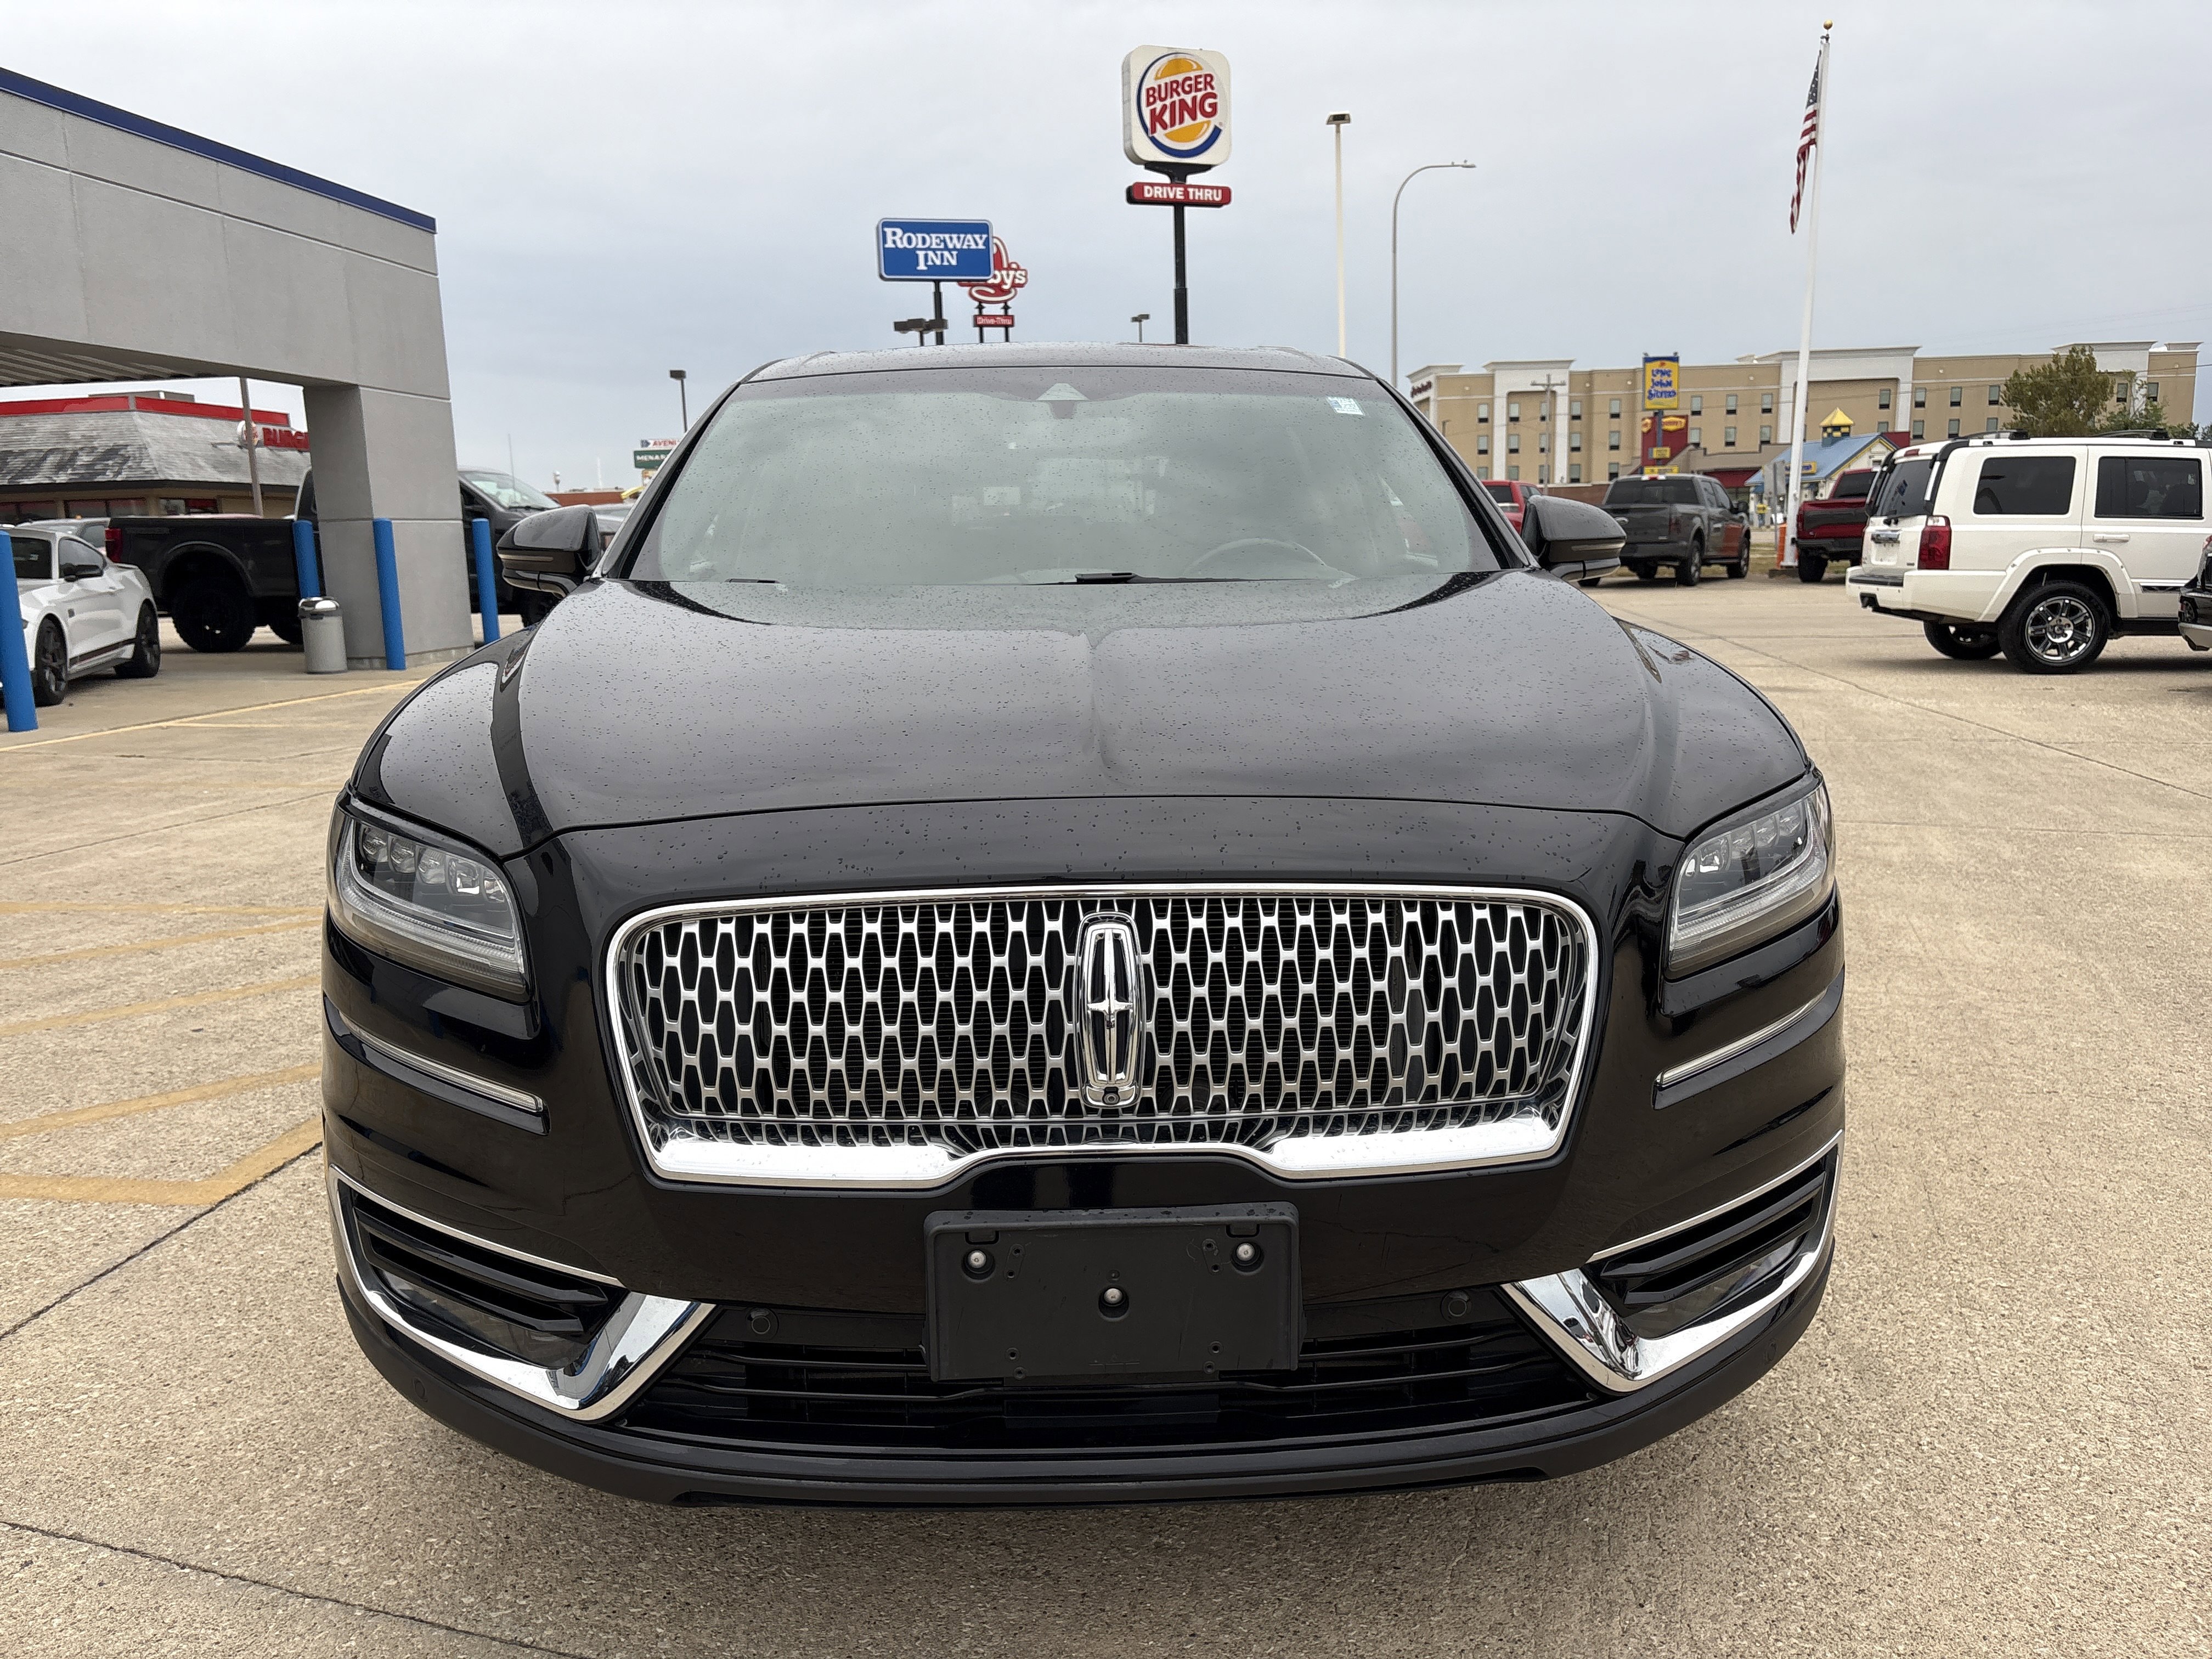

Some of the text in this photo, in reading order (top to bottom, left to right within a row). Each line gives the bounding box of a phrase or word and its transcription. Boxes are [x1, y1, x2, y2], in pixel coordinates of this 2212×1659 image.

[1145, 73, 1215, 107] BURGER
[1149, 92, 1218, 135] KING
[1143, 185, 1223, 201] DRIVE THRU
[883, 227, 988, 249] RODEWAY
[915, 250, 958, 270] INN
[986, 263, 1026, 290] by's
